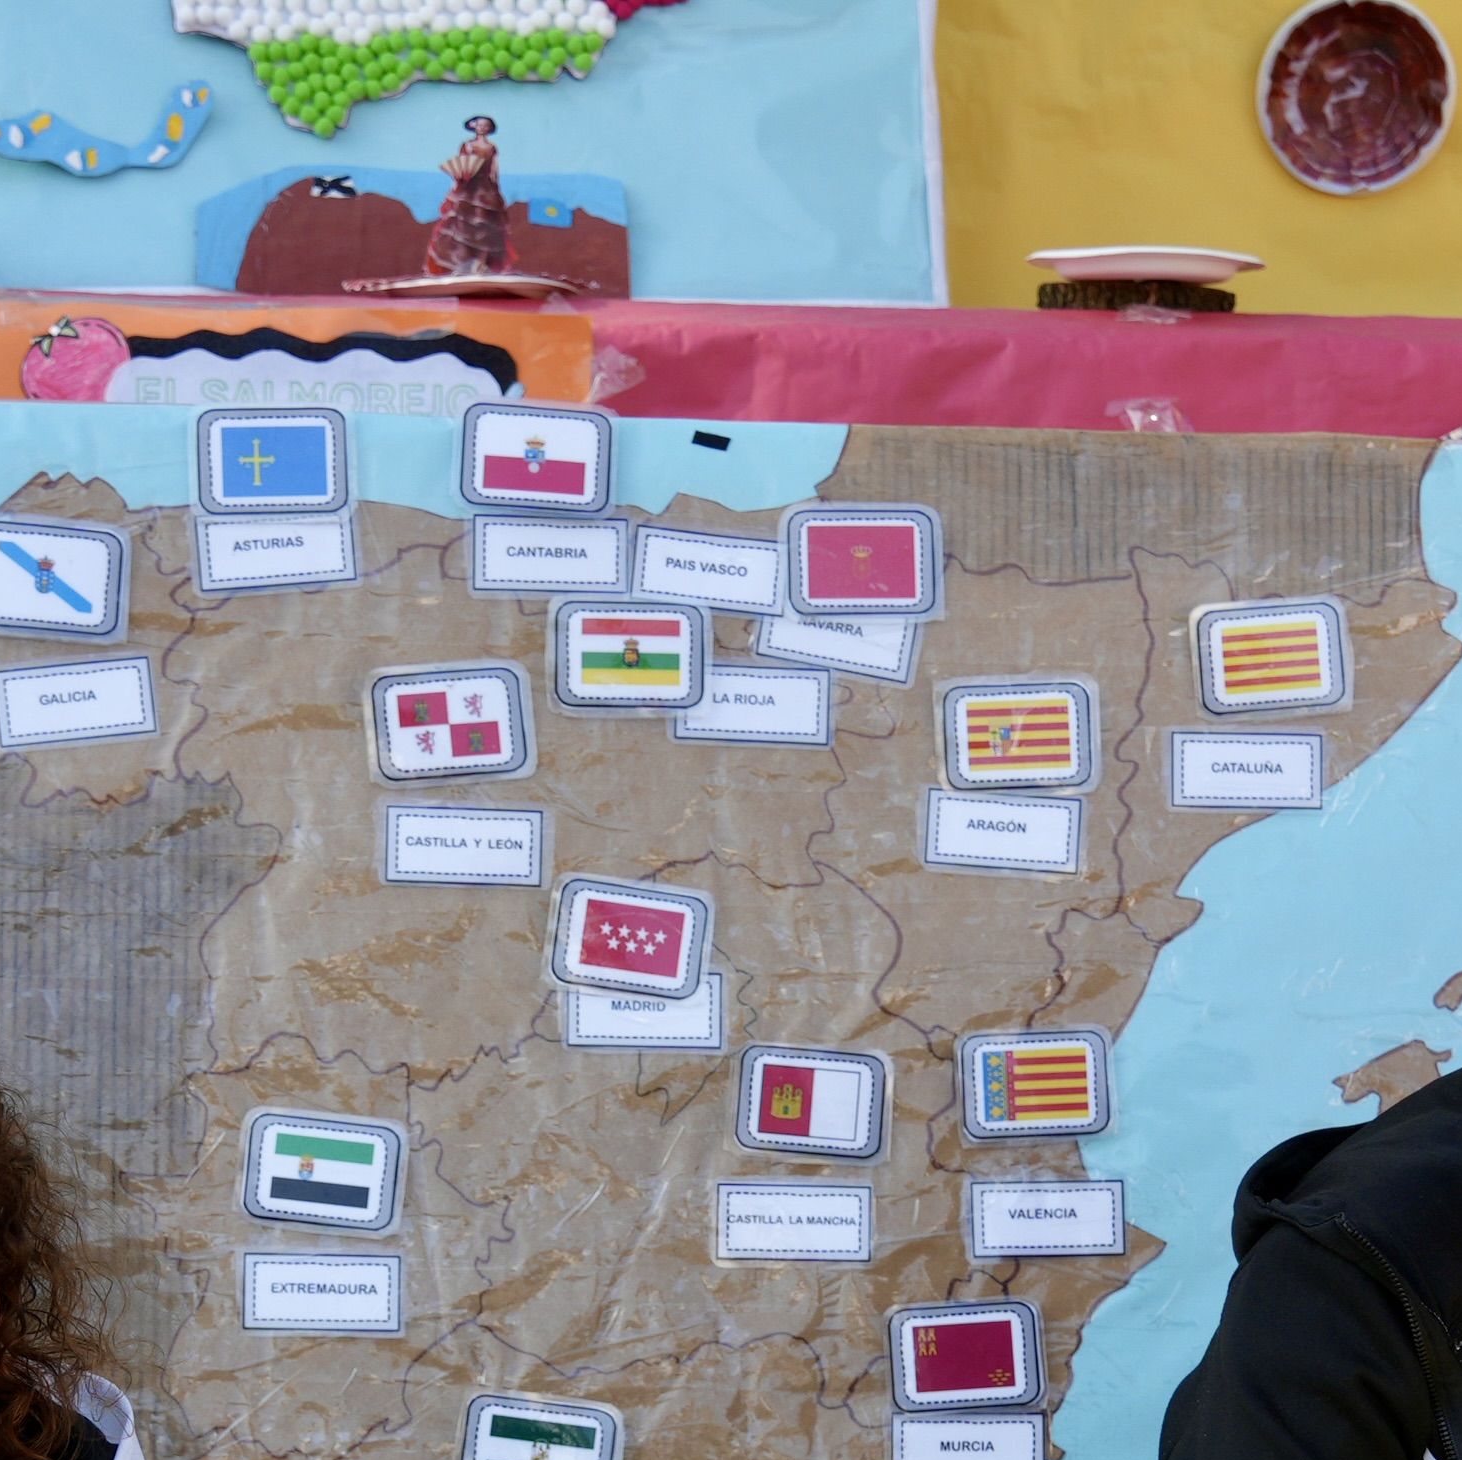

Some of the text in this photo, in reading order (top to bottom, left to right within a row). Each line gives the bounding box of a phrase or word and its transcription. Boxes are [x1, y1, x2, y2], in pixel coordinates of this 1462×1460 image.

[232, 535, 305, 552] ASTURIAS
[506, 545, 588, 559] CANTABRIA
[699, 561, 748, 578] VASCO
[38, 689, 98, 706] GALICIA
[712, 691, 776, 706] LA RIOJA
[1210, 761, 1284, 775] CATALUÑA
[966, 818, 1027, 834] ARAGÓN
[404, 835, 524, 851] CASTILLA Y LEÓN
[610, 997, 667, 1013] MADRID
[727, 1213, 857, 1226] CASTILLA LA MANCHA
[1008, 1207, 1078, 1220] VALENCIA
[270, 1282, 378, 1295] EXTREMADURA
[939, 1440, 995, 1452] MURCIA
